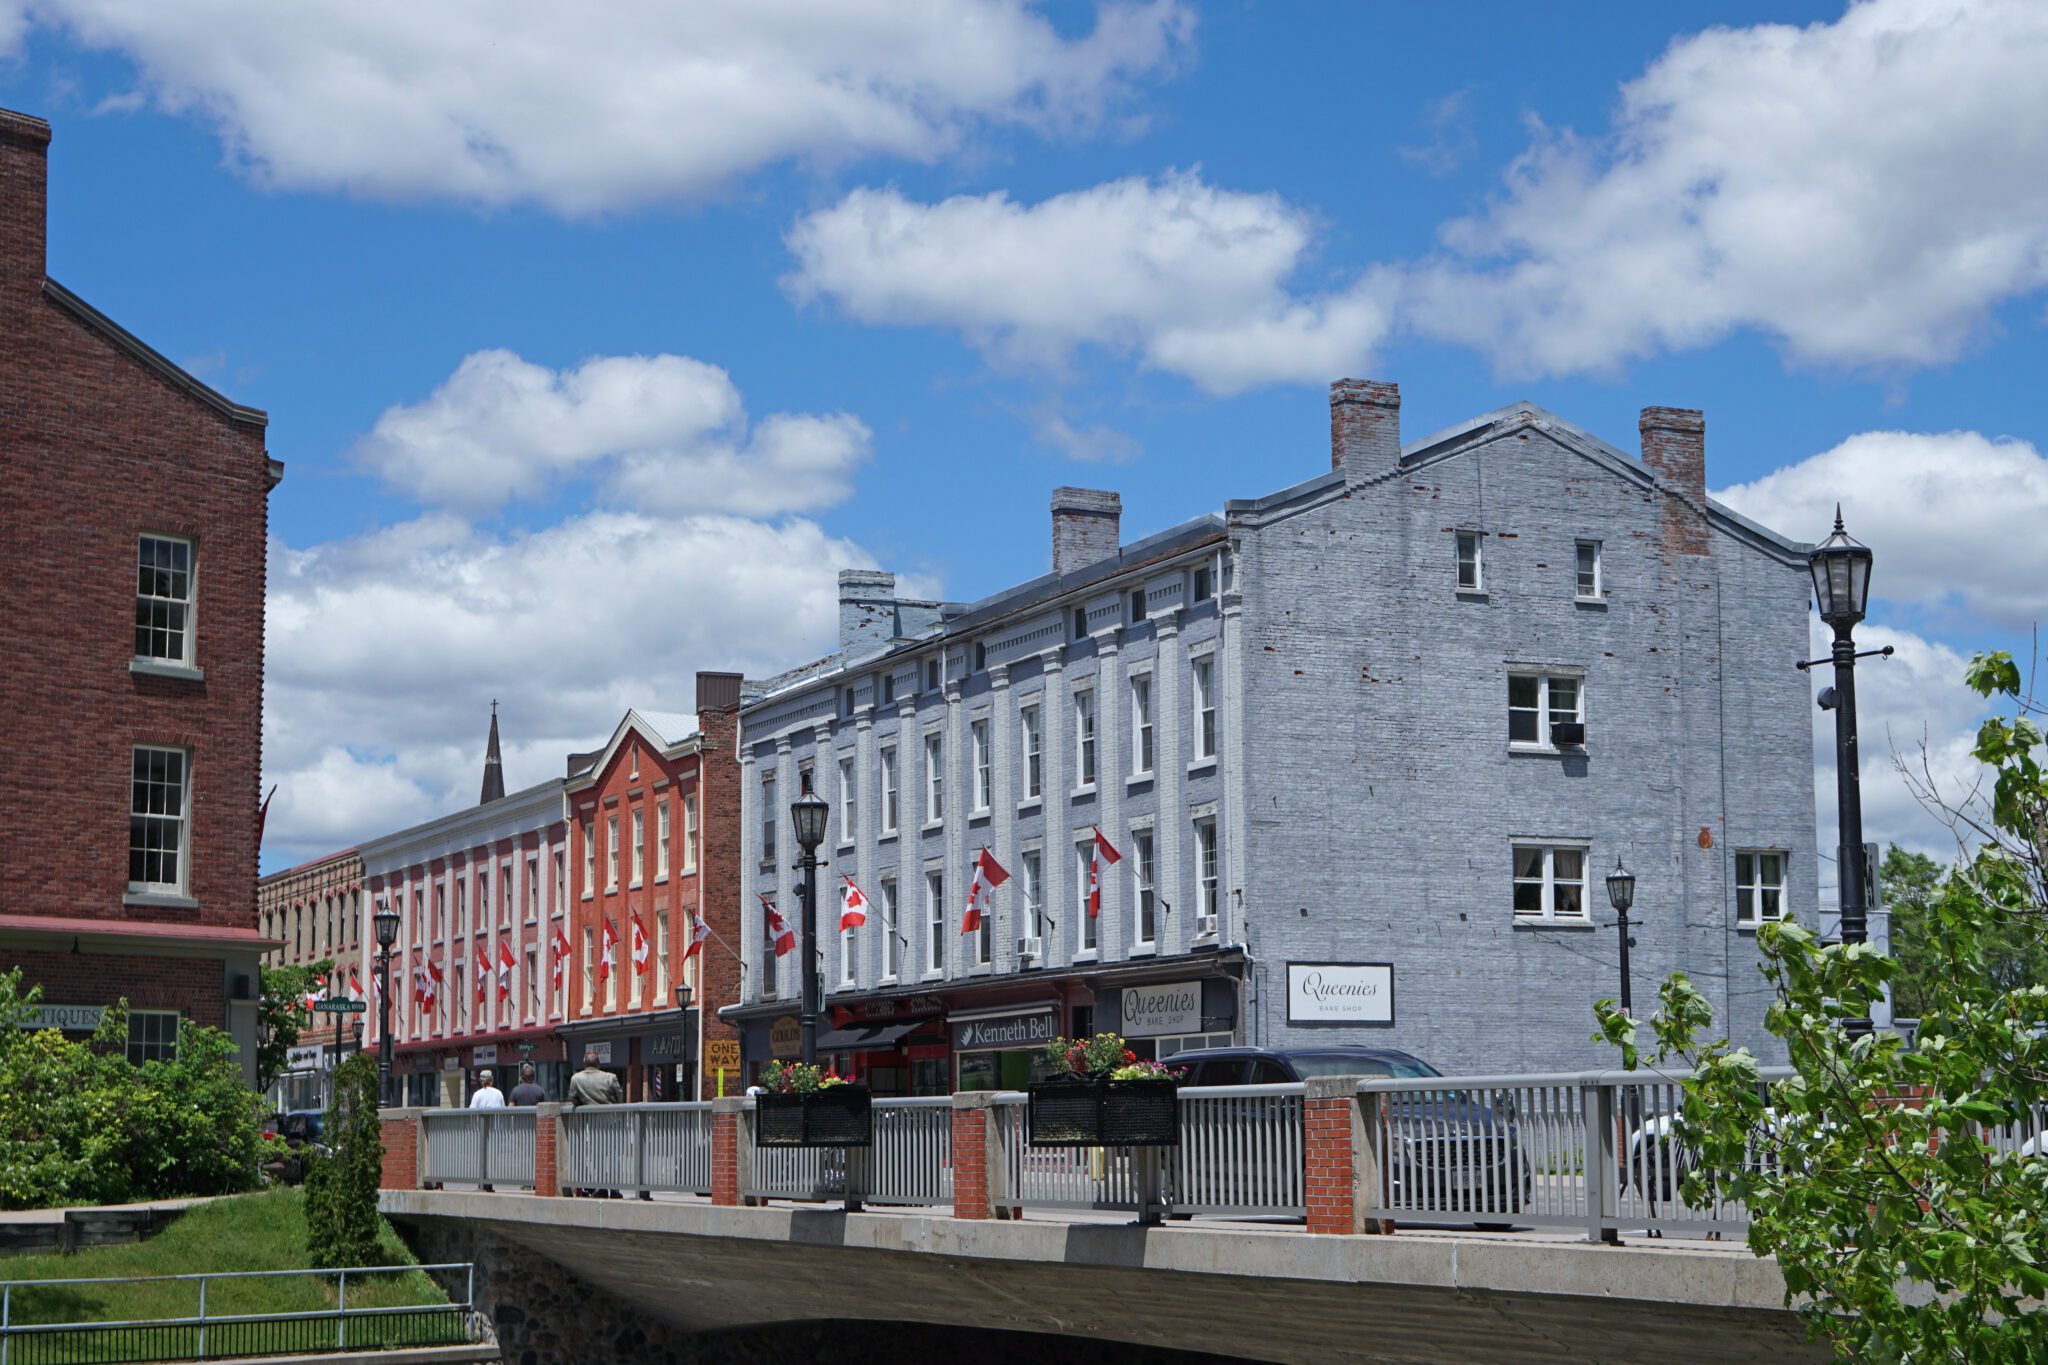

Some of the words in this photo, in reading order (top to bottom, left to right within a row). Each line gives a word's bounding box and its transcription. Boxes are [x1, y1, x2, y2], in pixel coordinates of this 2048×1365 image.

[1303, 971, 1377, 1002] Queenies
[315, 1003, 350, 1011] GANARASKA
[1124, 987, 1195, 1026] Queenies
[1147, 1017, 1163, 1026] BAKE
[1168, 1015, 1184, 1025] SHOP
[975, 1019, 1027, 1043] Kenneth
[1029, 1015, 1053, 1039] Bell
[711, 1043, 739, 1054] ONE
[710, 1055, 739, 1065] WAY
